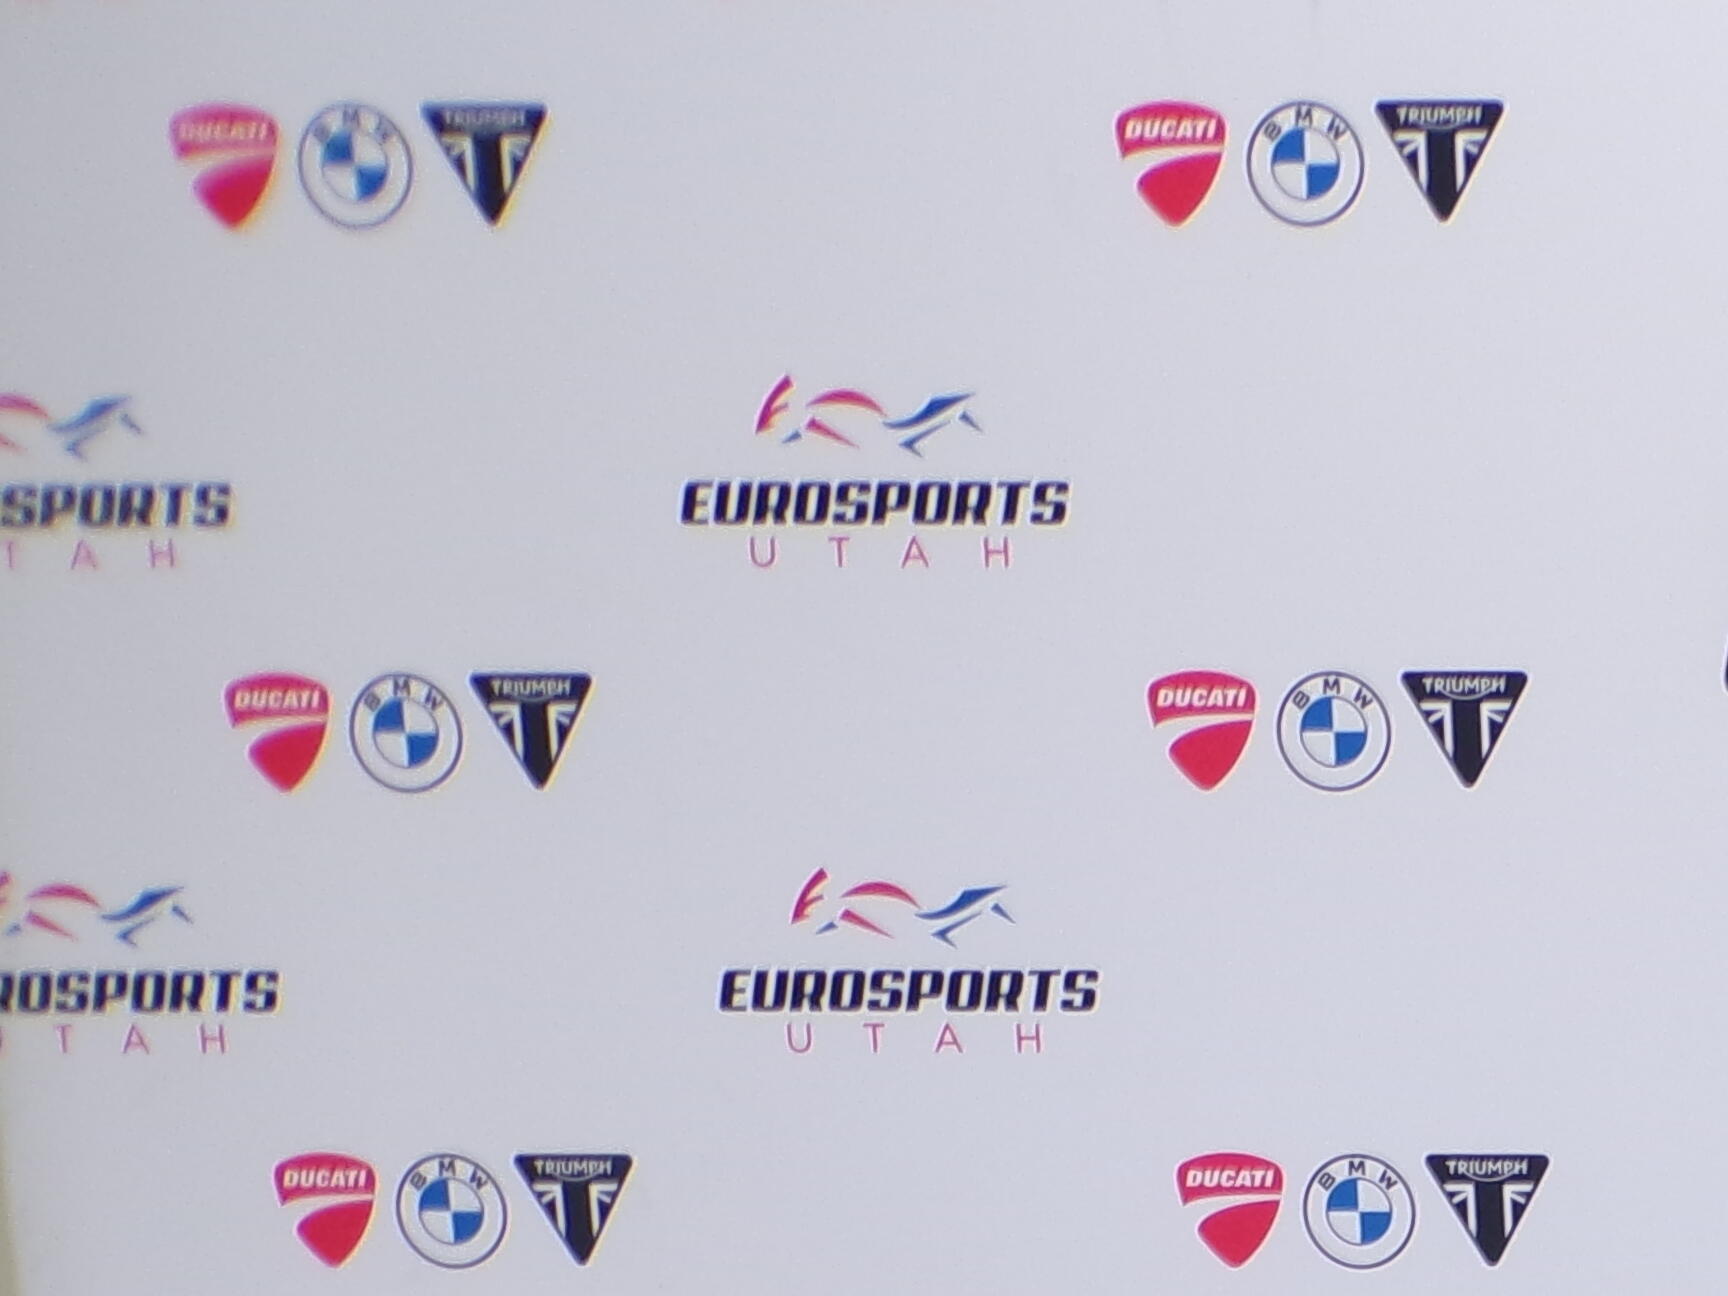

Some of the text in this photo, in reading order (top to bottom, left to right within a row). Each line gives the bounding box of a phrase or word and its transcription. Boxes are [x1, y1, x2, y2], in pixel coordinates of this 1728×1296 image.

[1125, 119, 1217, 139] DUCATI
[1263, 109, 1349, 140] BMW
[1396, 108, 1482, 123] TRIUMPH
[1, 486, 231, 528] SPORTS
[682, 482, 1070, 526] EUROSPORTS
[748, 536, 1012, 570] UTAH
[235, 690, 319, 708] DUCATI
[363, 680, 444, 710] BMW
[491, 680, 571, 695] TRIUMPH
[1156, 688, 1247, 707] DUCATI
[1292, 678, 1374, 710] BMW
[1422, 677, 1506, 693] TRIUMPH
[720, 970, 1099, 1012] EUROSPORTS
[0, 1023, 227, 1055] TAH
[786, 1022, 1043, 1055] UTAH
[283, 1169, 366, 1188] DUCATI
[411, 1161, 488, 1189] BMW
[534, 1160, 613, 1175] TRIUMPH
[1186, 1169, 1274, 1188] DUCATI
[1319, 1161, 1398, 1190] BMW
[1445, 1160, 1528, 1175] TRIUMPH
